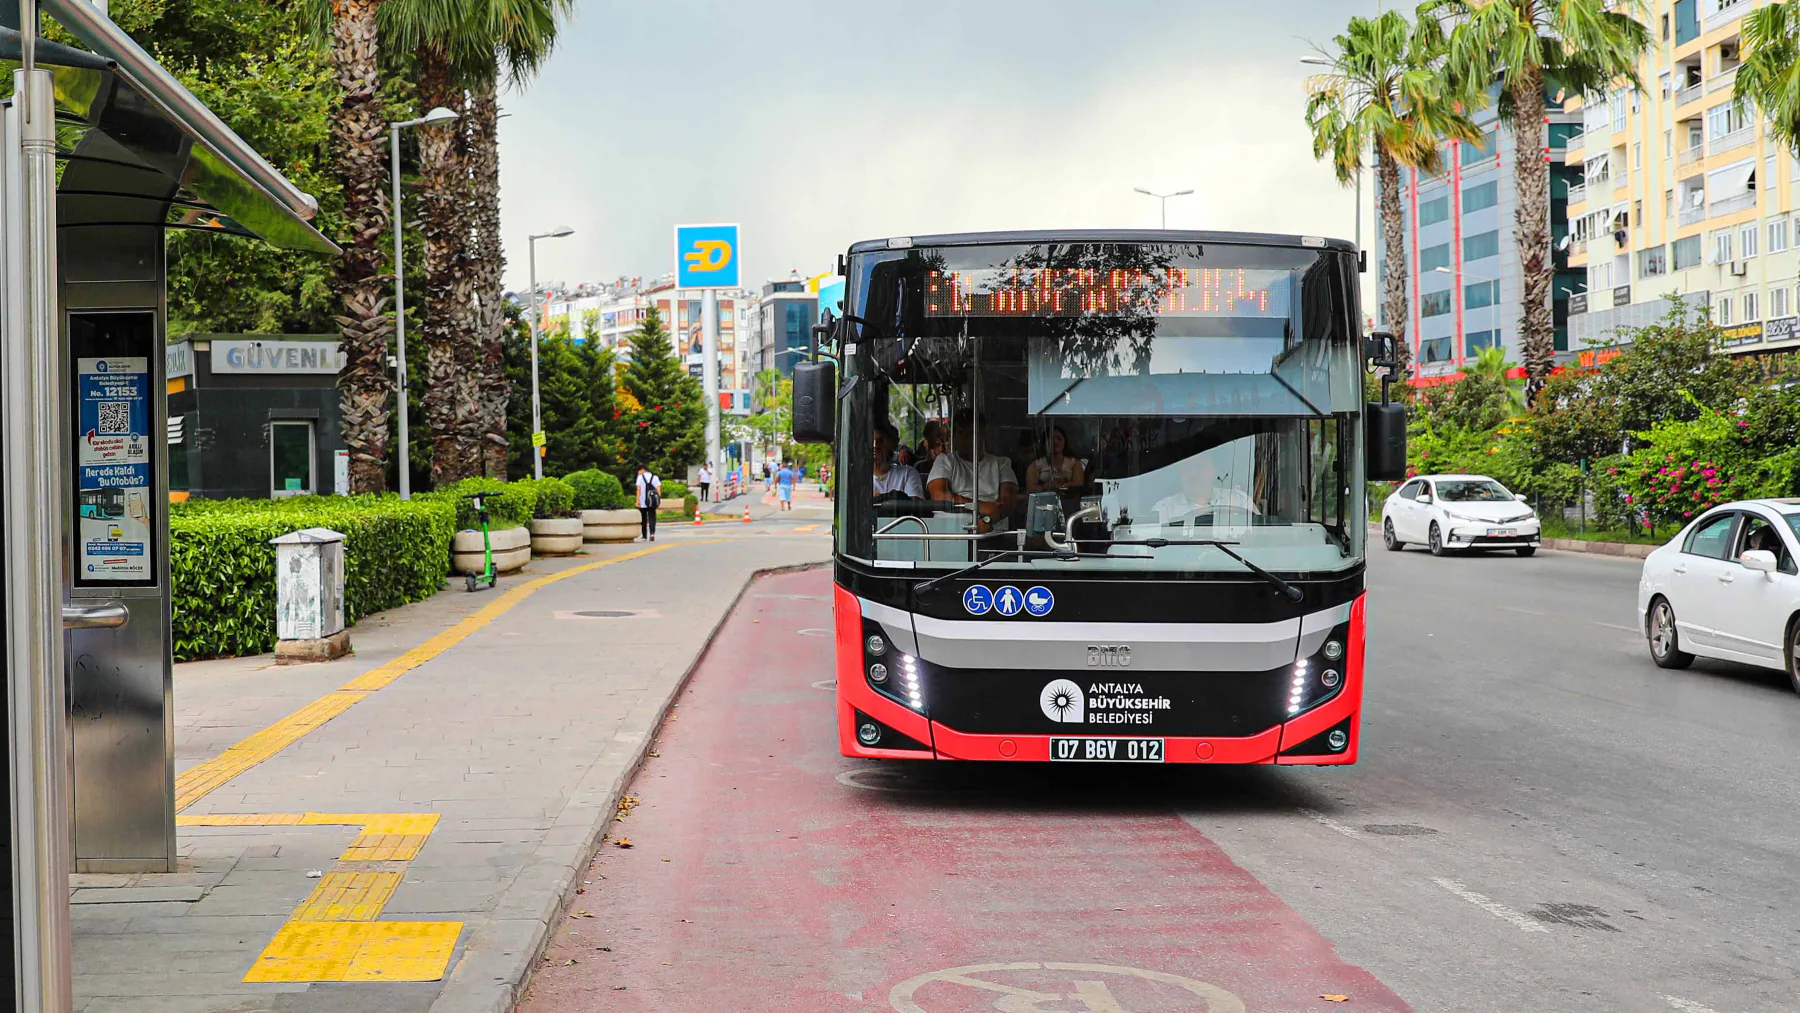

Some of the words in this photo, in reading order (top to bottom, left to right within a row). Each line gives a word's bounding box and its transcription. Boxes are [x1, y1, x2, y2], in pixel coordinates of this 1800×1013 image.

[226, 342, 345, 369] GÜVENLİ
[104, 386, 138, 397] 12153
[114, 466, 135, 476] Kaldı
[98, 477, 110, 487] Bu
[110, 475, 144, 486] Otobüs?
[1087, 645, 1131, 667] BMC
[1088, 683, 1144, 694] ANTALYA
[1089, 711, 1153, 724] BELEDİYESİ
[1058, 740, 1079, 759] 07
[1085, 740, 1117, 759] BGV
[1127, 741, 1160, 760] 012
